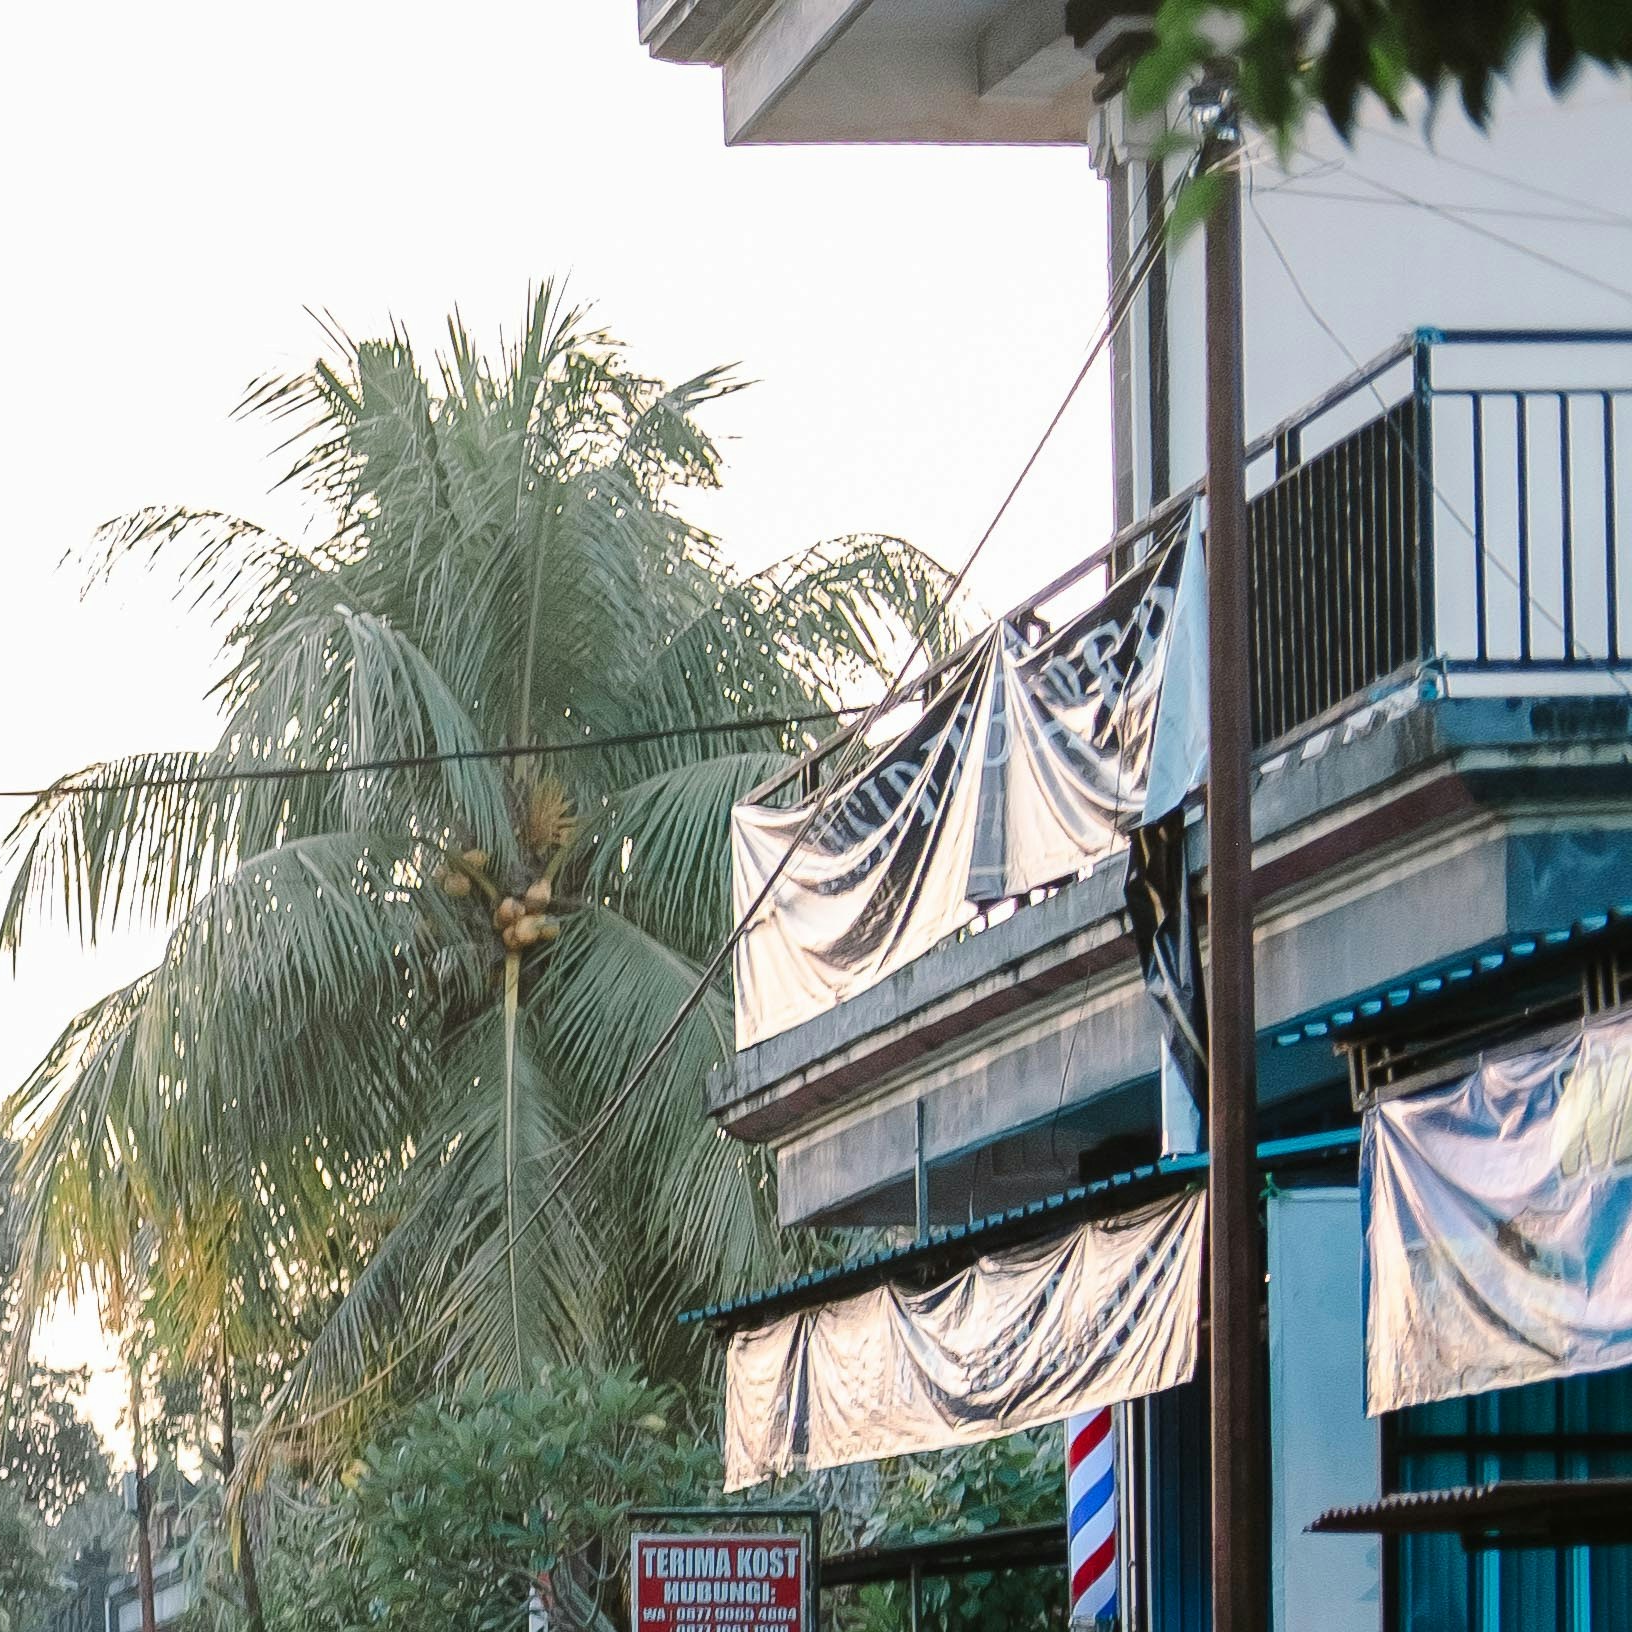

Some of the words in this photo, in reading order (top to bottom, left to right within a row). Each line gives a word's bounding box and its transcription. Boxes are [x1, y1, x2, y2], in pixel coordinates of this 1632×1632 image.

[642, 1547, 732, 1579] TERIMA
[737, 1547, 799, 1579] KOST
[663, 1581, 776, 1605] HUBUNGI:
